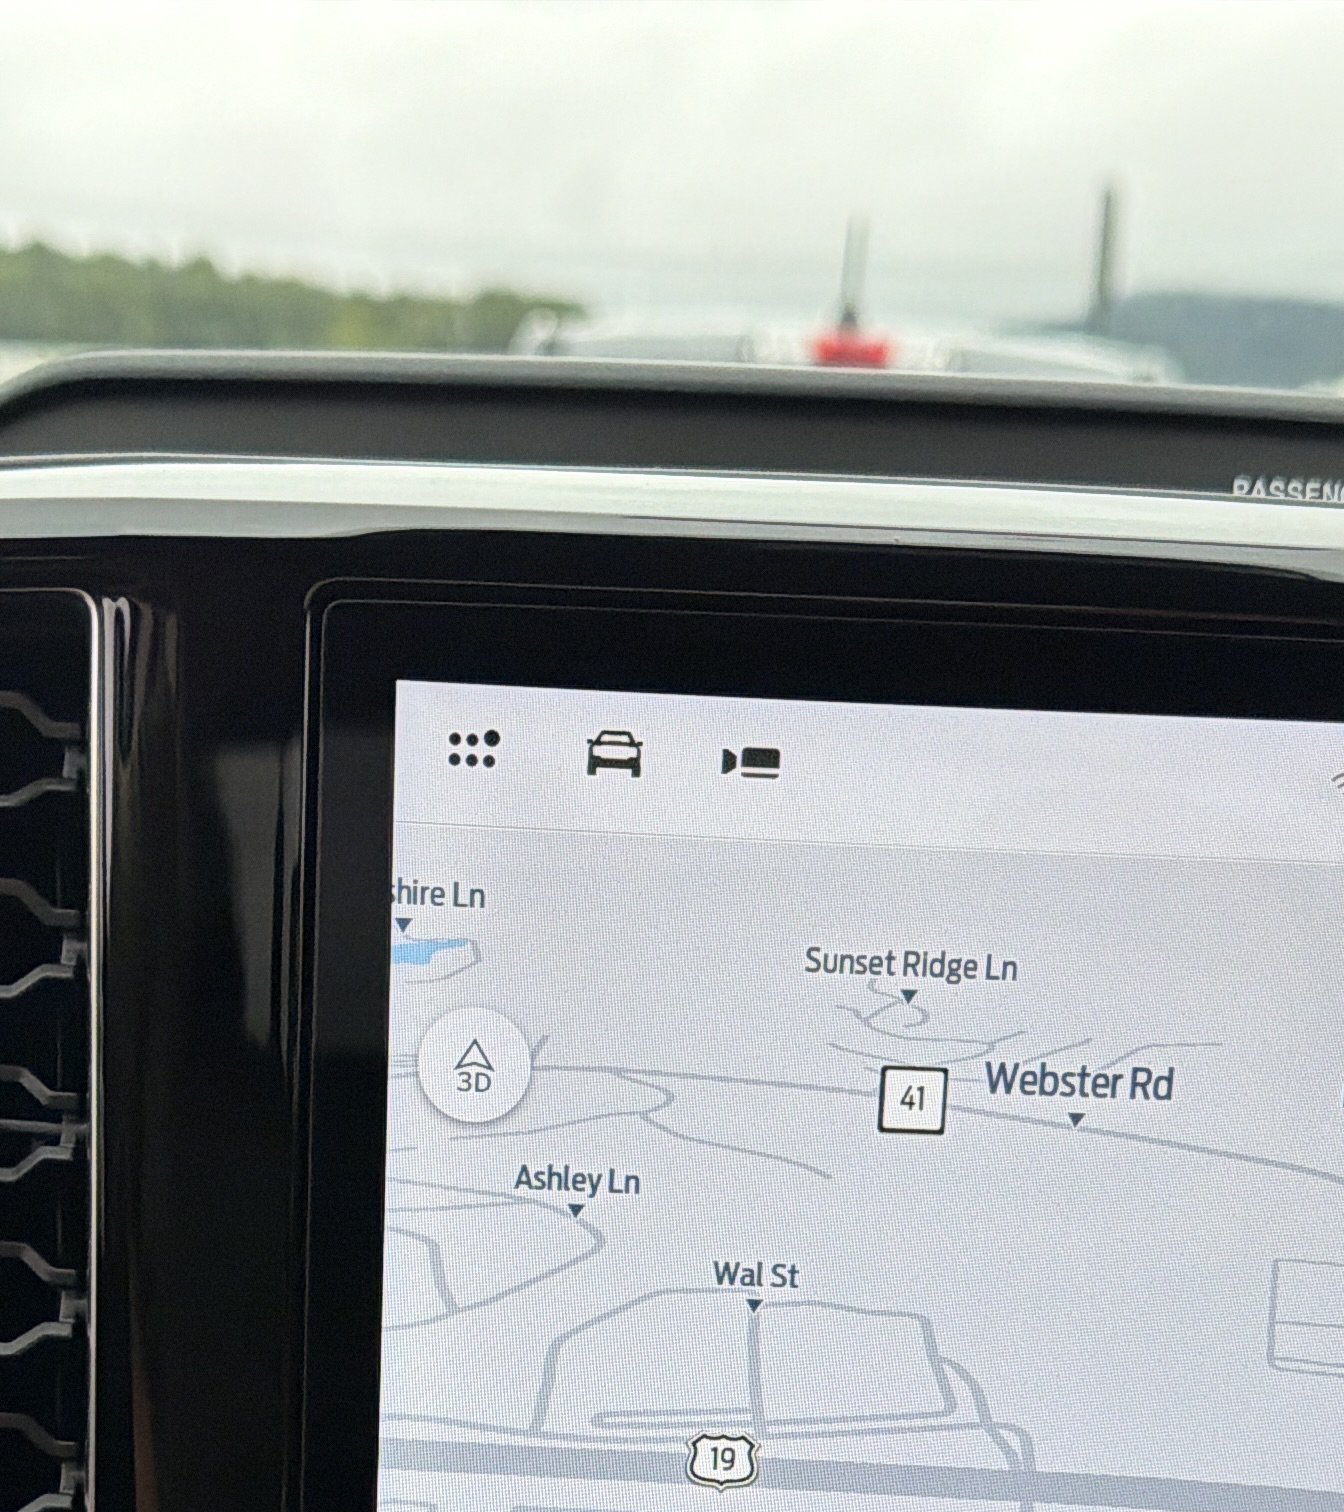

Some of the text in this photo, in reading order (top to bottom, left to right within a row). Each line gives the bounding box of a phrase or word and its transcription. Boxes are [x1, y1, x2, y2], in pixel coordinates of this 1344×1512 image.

[452, 881, 486, 909] Ln
[804, 946, 1018, 985] Sunset Ridge Ln
[454, 1070, 495, 1095] 3D
[985, 1061, 1175, 1101] Webster Rd
[899, 1085, 925, 1111] 41
[514, 1163, 641, 1199] Ashley Ln
[713, 1261, 799, 1289] Wal St
[710, 1446, 736, 1472] 19
